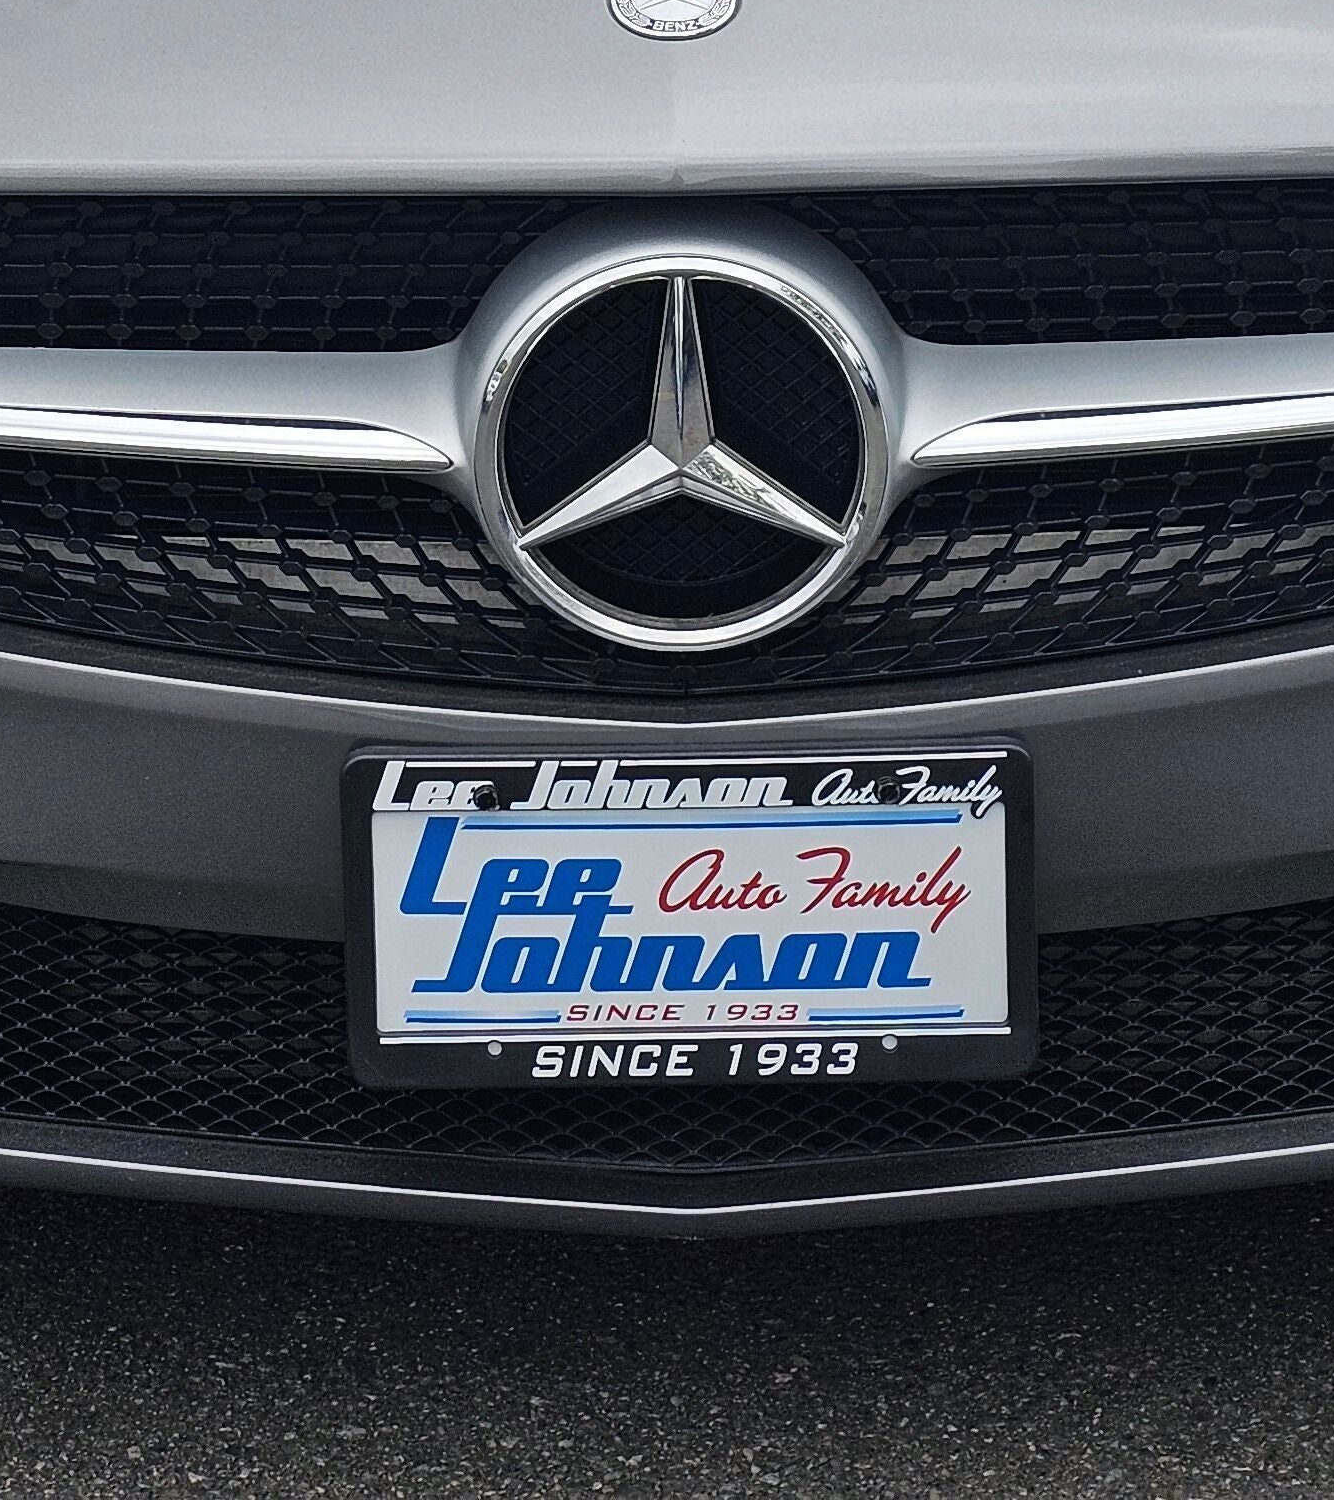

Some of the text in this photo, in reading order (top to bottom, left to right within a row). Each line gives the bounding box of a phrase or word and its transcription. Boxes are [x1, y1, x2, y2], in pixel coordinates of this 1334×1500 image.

[652, 19, 698, 33] BENZ
[510, 759, 793, 809] Johnson
[812, 768, 887, 806] Aut
[895, 765, 1003, 817] Family
[399, 815, 972, 934] Lee Auto Family
[411, 898, 932, 994] Johnson
[566, 1003, 800, 1022] SINCE 1933
[531, 1042, 860, 1078] SINCE 1933
